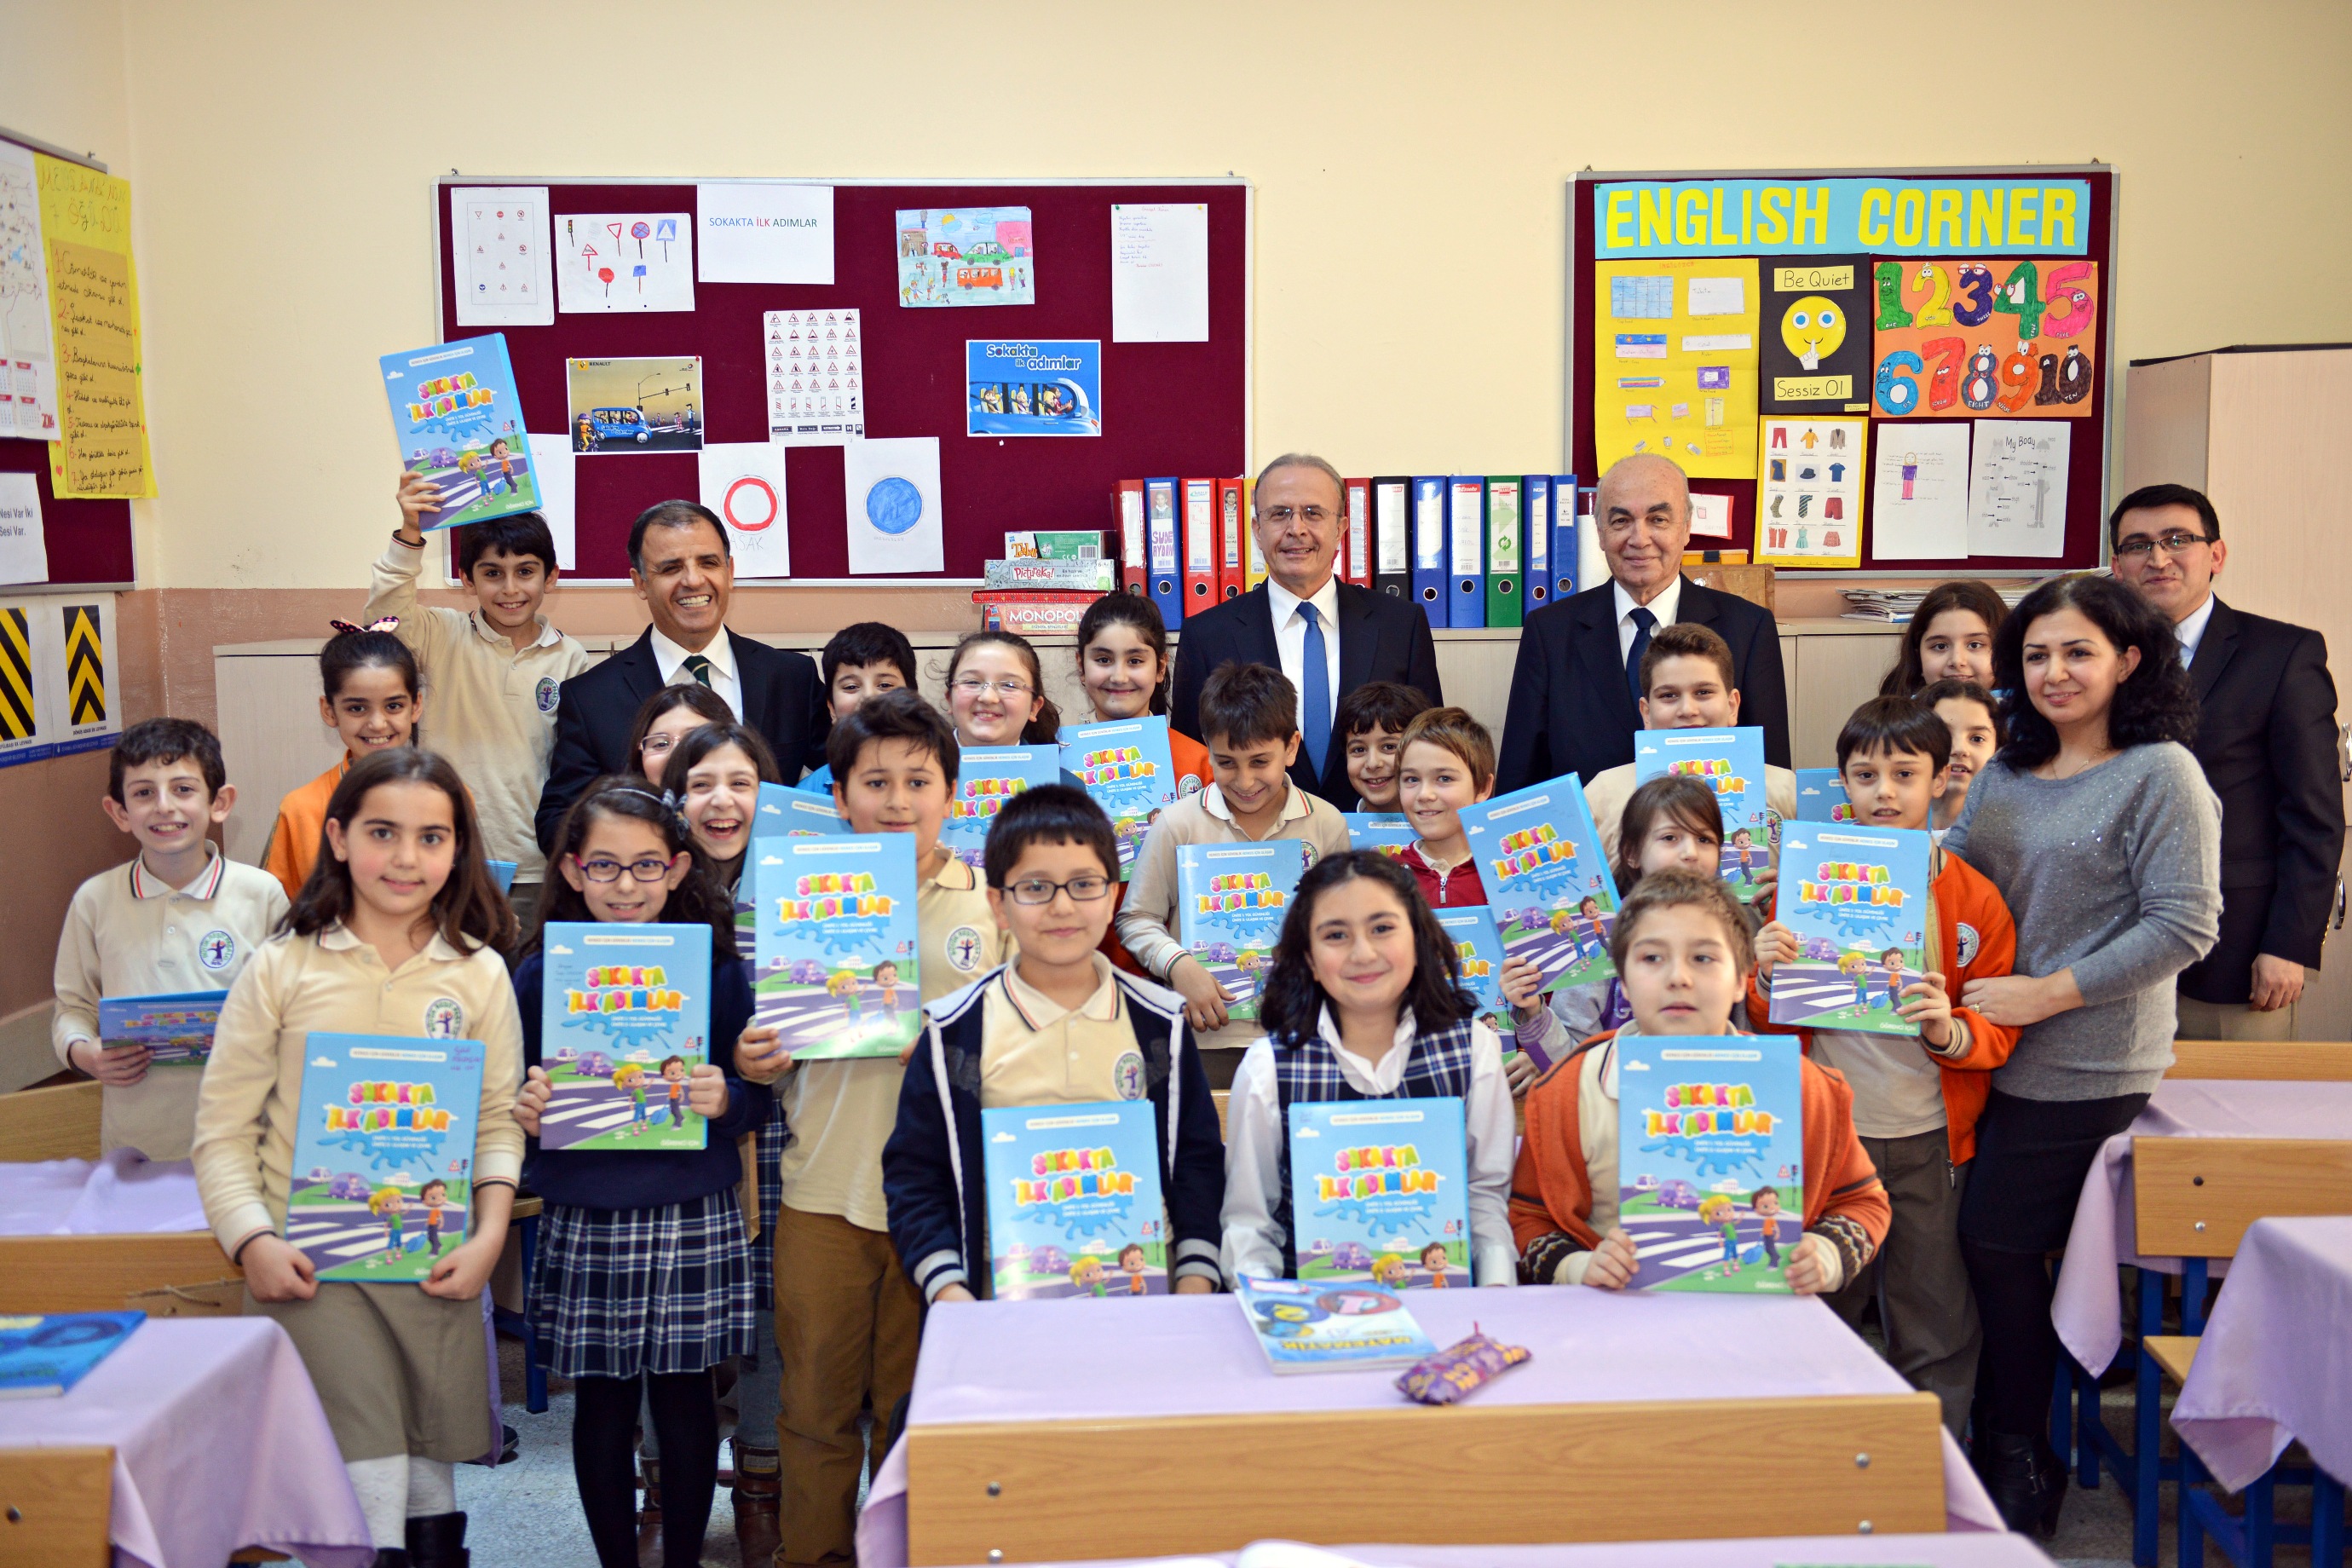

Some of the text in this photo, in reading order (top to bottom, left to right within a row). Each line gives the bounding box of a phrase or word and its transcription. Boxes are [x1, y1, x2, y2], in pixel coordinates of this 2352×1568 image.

[709, 216, 818, 228] SOKAKTA İLK ADIMLAR
[1606, 187, 2077, 248] ENGLISH CORNER
[1784, 270, 1850, 288] Be Quiet
[1875, 261, 2094, 340] 1 2 3 4 5
[987, 343, 1038, 357] Sokakta
[1016, 355, 1082, 371] ilk adımlar
[418, 372, 477, 400] SOKAKTA
[1875, 337, 2093, 415] 6 7 8 9 10
[1777, 379, 1843, 398] Sessiz Ol
[435, 388, 493, 417] ADIMLAR
[2005, 435, 2036, 453] My Body
[13, 508, 24, 519] Var
[25, 505, 33, 518] İki
[13, 526, 26, 536] Var.
[729, 534, 764, 551] ASAK
[1152, 531, 1173, 545] SUDE
[1012, 543, 1038, 558] Tabu
[1014, 567, 1055, 580] Pictureka!
[1009, 610, 1086, 622] MONOPOL
[1083, 746, 1142, 768] SOKAKTA
[1098, 762, 1156, 785] ADIMLAR
[1703, 775, 1745, 794] MLAR
[965, 777, 1028, 798] SOKAKTA
[1500, 822, 1558, 855] SOKAKTA
[1519, 840, 1576, 875] ADIMLAR
[796, 871, 877, 896] SOKAKTA
[1210, 872, 1271, 892] SOKAKTA
[1817, 861, 1892, 885] SOKAKTA
[1224, 890, 1284, 913] ADIMLAR
[1830, 883, 1904, 907] ADIMLAR
[813, 895, 892, 923] ADIMLAR
[586, 966, 667, 989] SOKAKTA
[602, 989, 683, 1013] ADIMLAR
[348, 1081, 436, 1106] SOKAKTA
[1664, 1082, 1756, 1109] SOKAKTA
[362, 1108, 451, 1133] ADIMLAR
[1683, 1109, 1773, 1138] ADIMLAR
[1031, 1145, 1116, 1176] SOKAKTA
[1335, 1144, 1421, 1173] SOKAKTA
[1052, 1171, 1134, 1204] ADIMLAR
[1354, 1169, 1438, 1202] ADIMLAR
